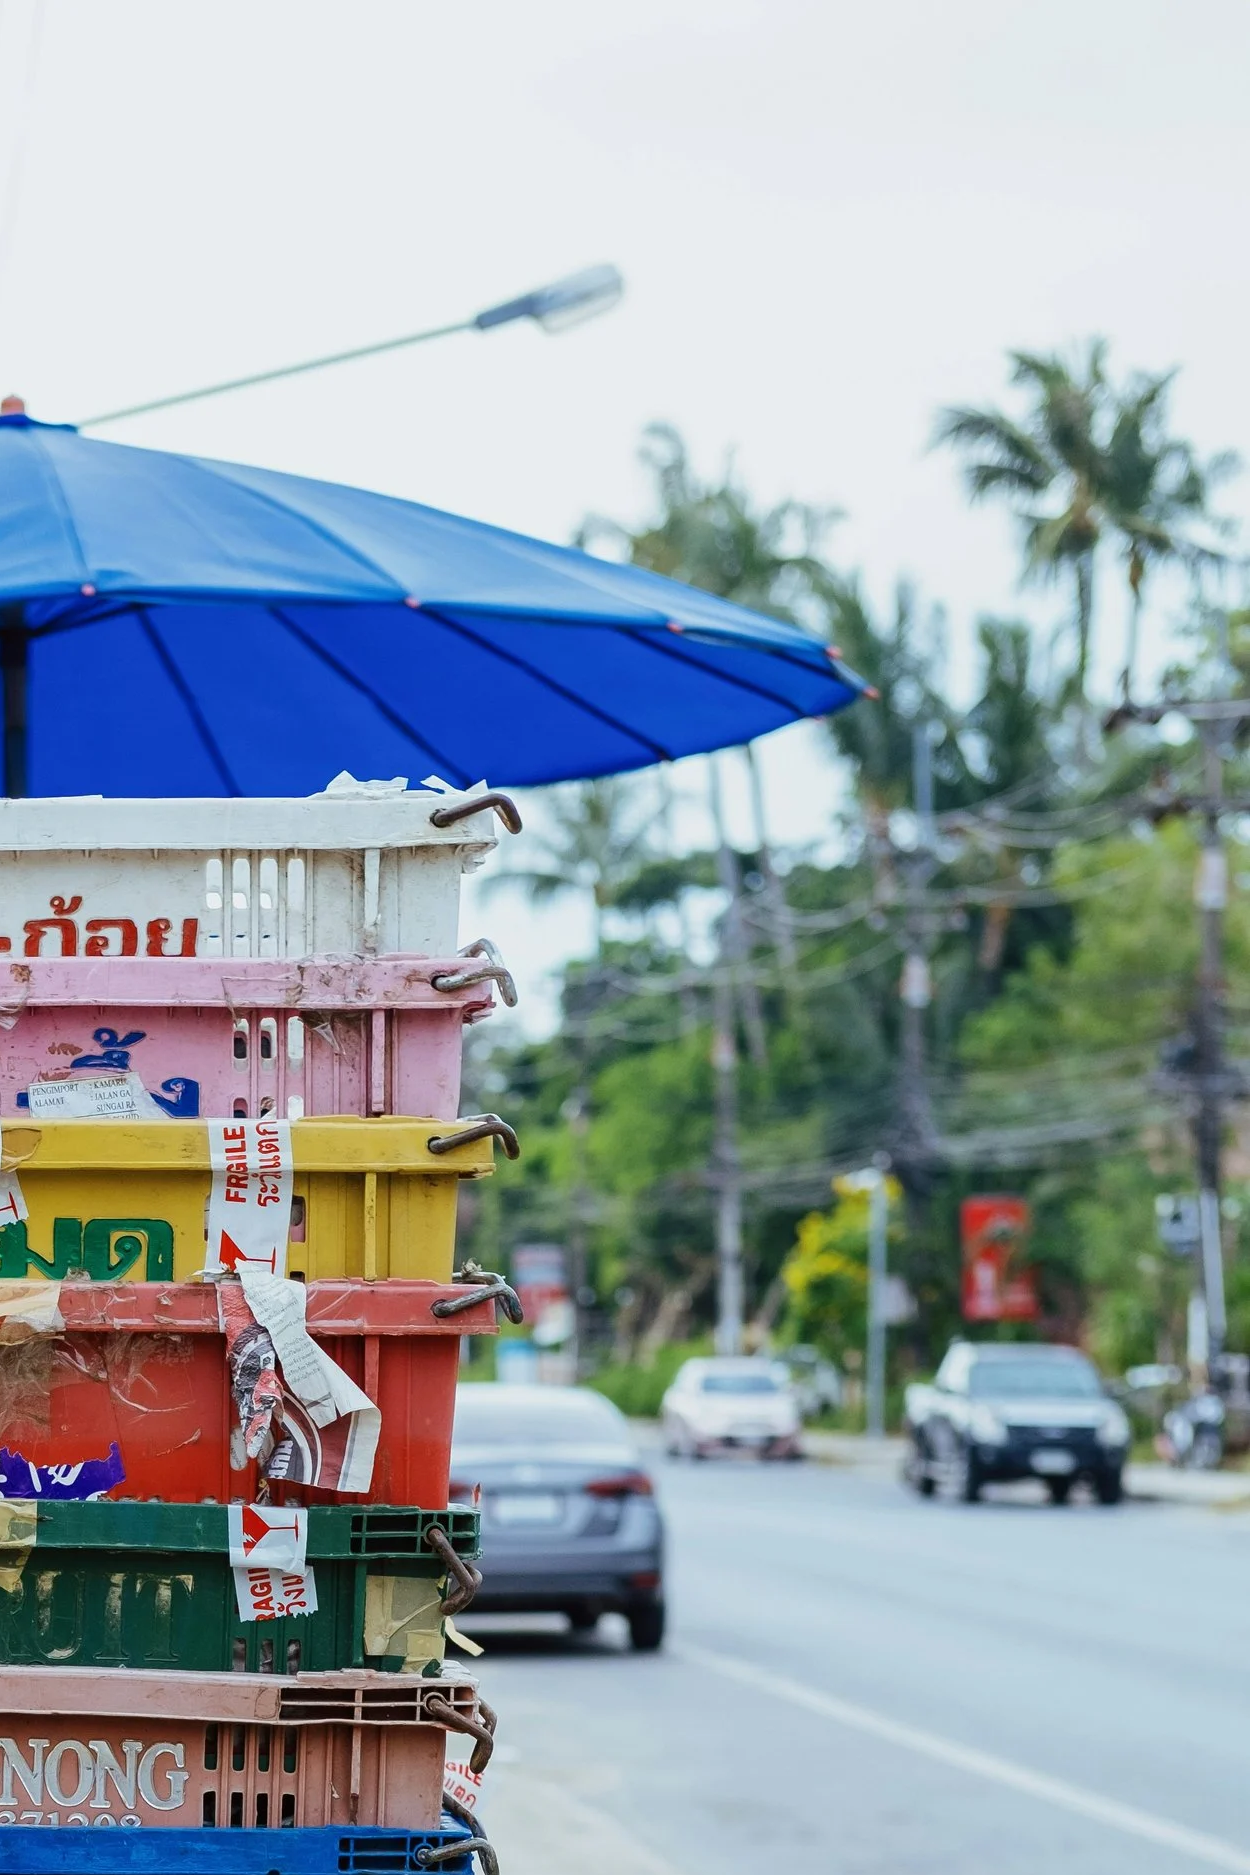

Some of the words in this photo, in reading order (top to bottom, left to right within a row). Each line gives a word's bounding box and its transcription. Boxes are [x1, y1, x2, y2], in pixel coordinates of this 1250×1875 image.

[32, 1083, 79, 1097] PENGIMPORT
[34, 1096, 65, 1108] ALAMAT
[94, 1090, 119, 1101] JALAN
[96, 1101, 125, 1112] SUNGAI
